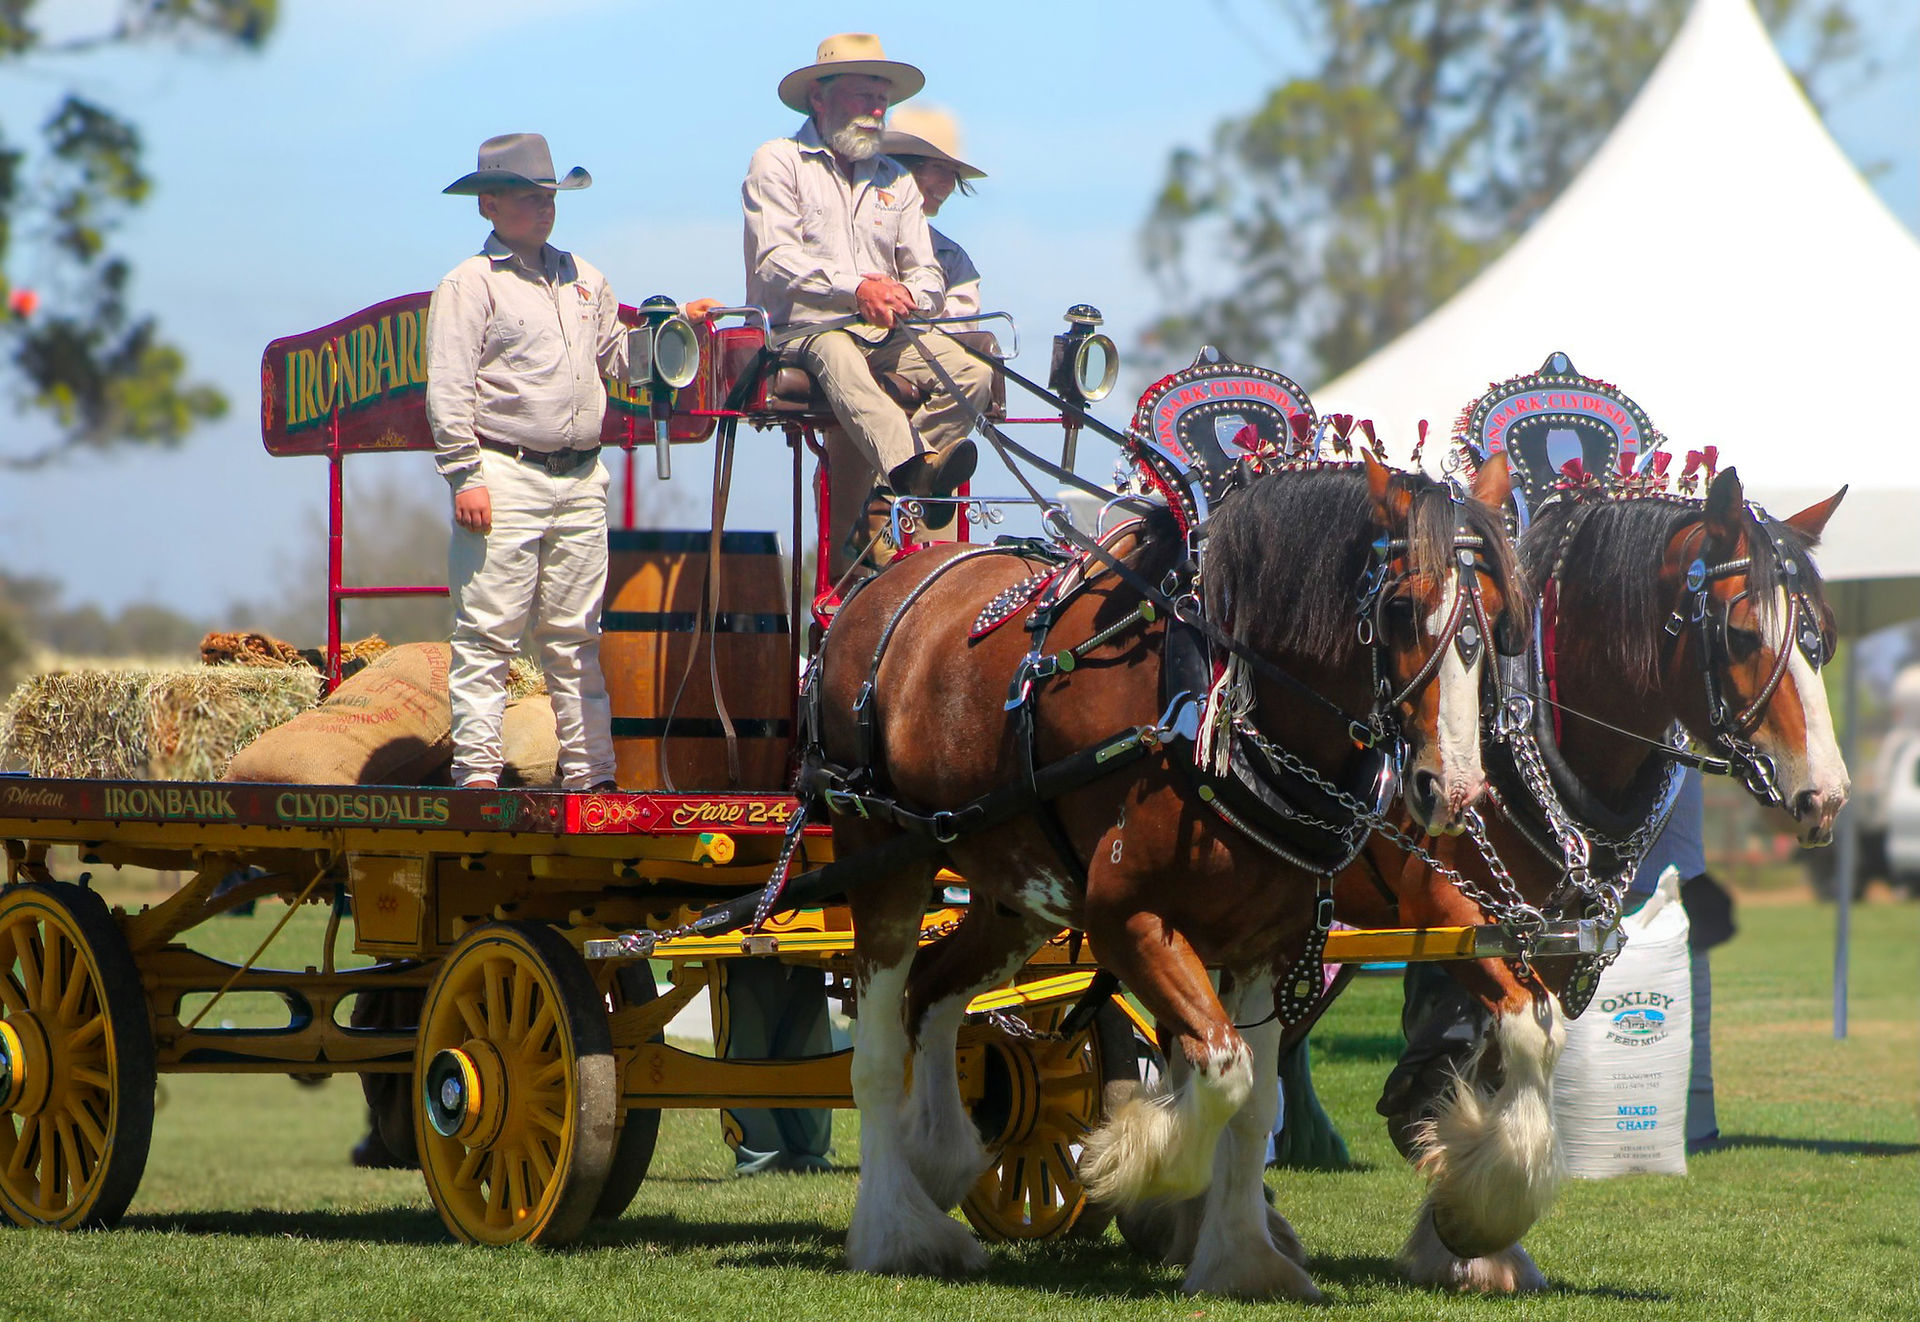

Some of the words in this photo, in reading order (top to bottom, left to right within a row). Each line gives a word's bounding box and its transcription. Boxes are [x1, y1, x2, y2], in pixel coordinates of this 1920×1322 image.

[1210, 381, 1300, 419] CLYDESDA
[1488, 397, 1543, 454] ONBARK
[1548, 393, 1637, 452] CLYDESDAL
[105, 788, 237, 819] IRONBARK
[275, 792, 450, 824] CLYDESDALES
[672, 802, 744, 826] Tare
[1110, 839, 1123, 864] 8
[1600, 992, 1675, 1013] OXLEY
[1605, 1031, 1639, 1047] FEED
[1640, 1030, 1669, 1047] MILL
[1617, 1105, 1658, 1116] MIXED
[1616, 1121, 1658, 1131] CHAFF
